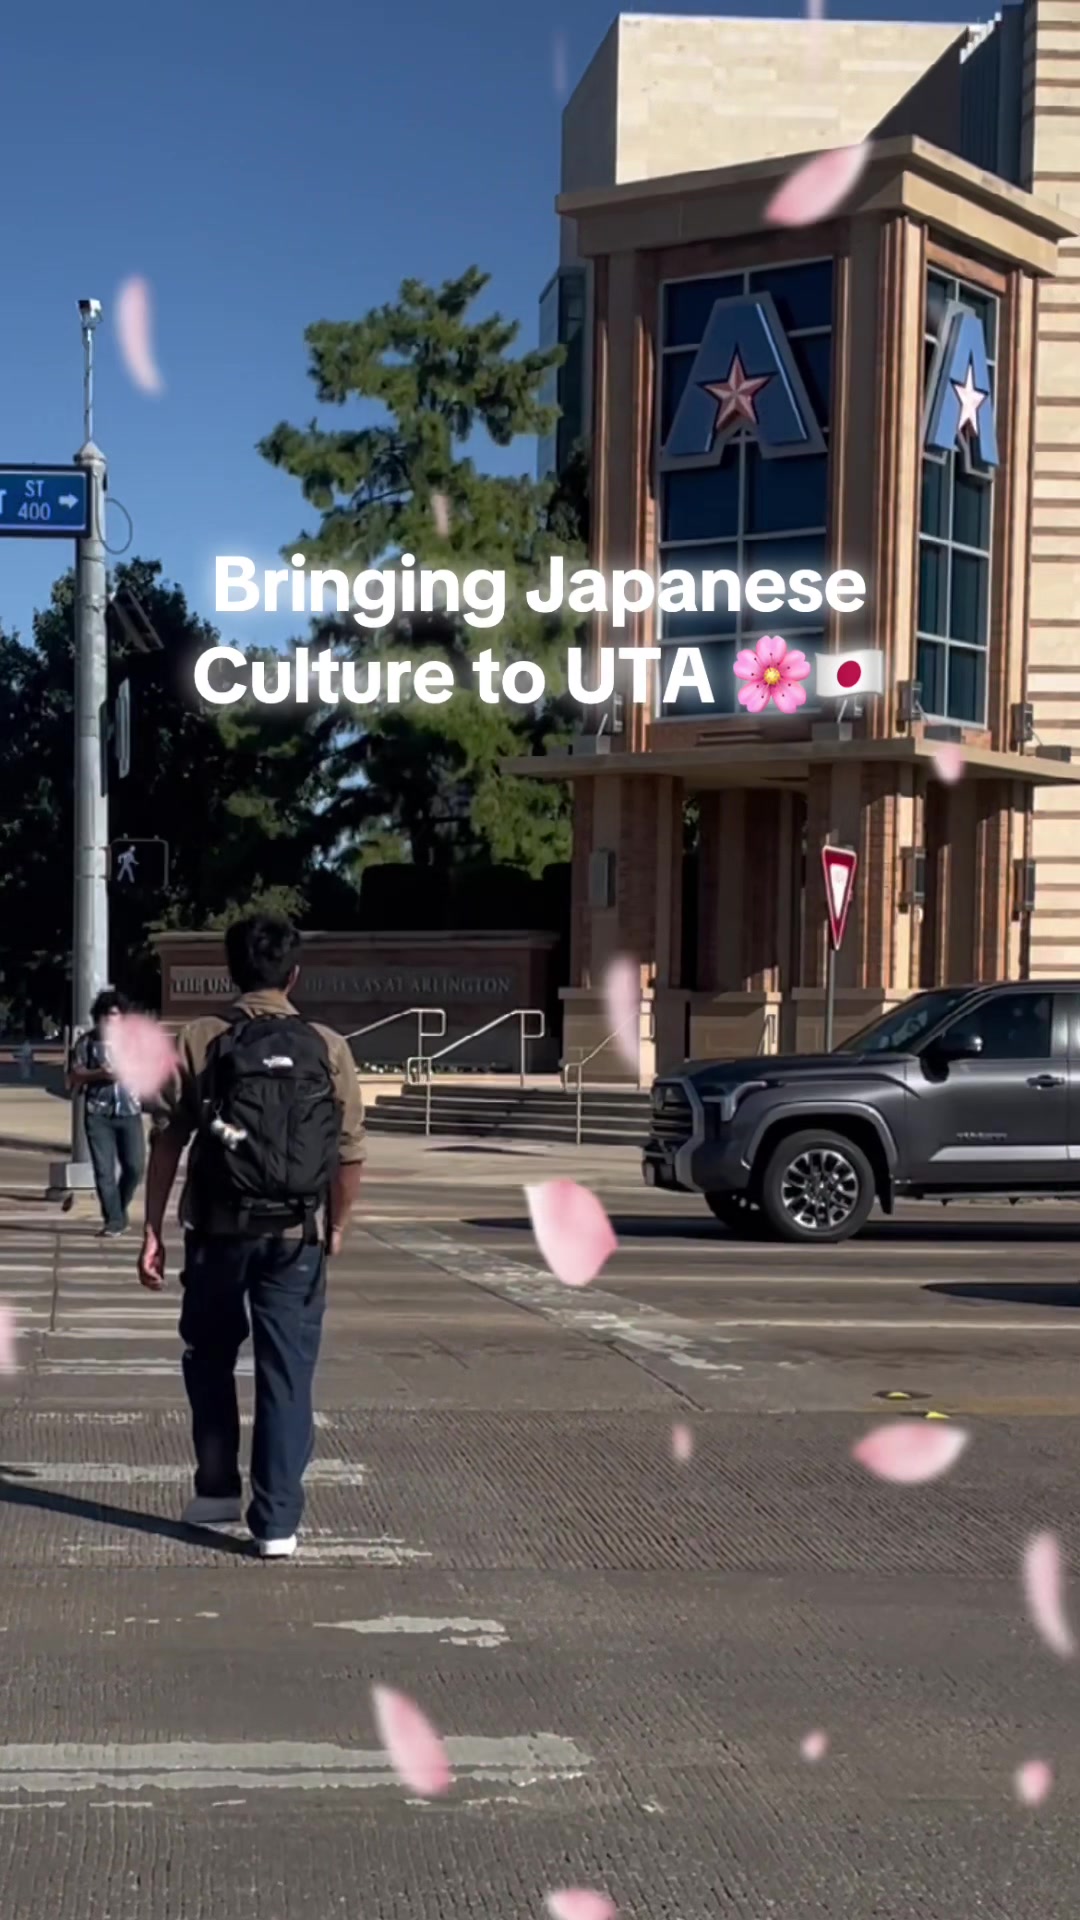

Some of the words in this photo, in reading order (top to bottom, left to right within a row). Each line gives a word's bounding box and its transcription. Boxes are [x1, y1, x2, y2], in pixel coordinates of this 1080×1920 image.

[658, 291, 828, 471] A
[921, 299, 1000, 475] A
[25, 480, 44, 497] ST
[18, 502, 51, 520] 400
[174, 977, 203, 993] THE
[411, 975, 511, 993] ARLINGTON
